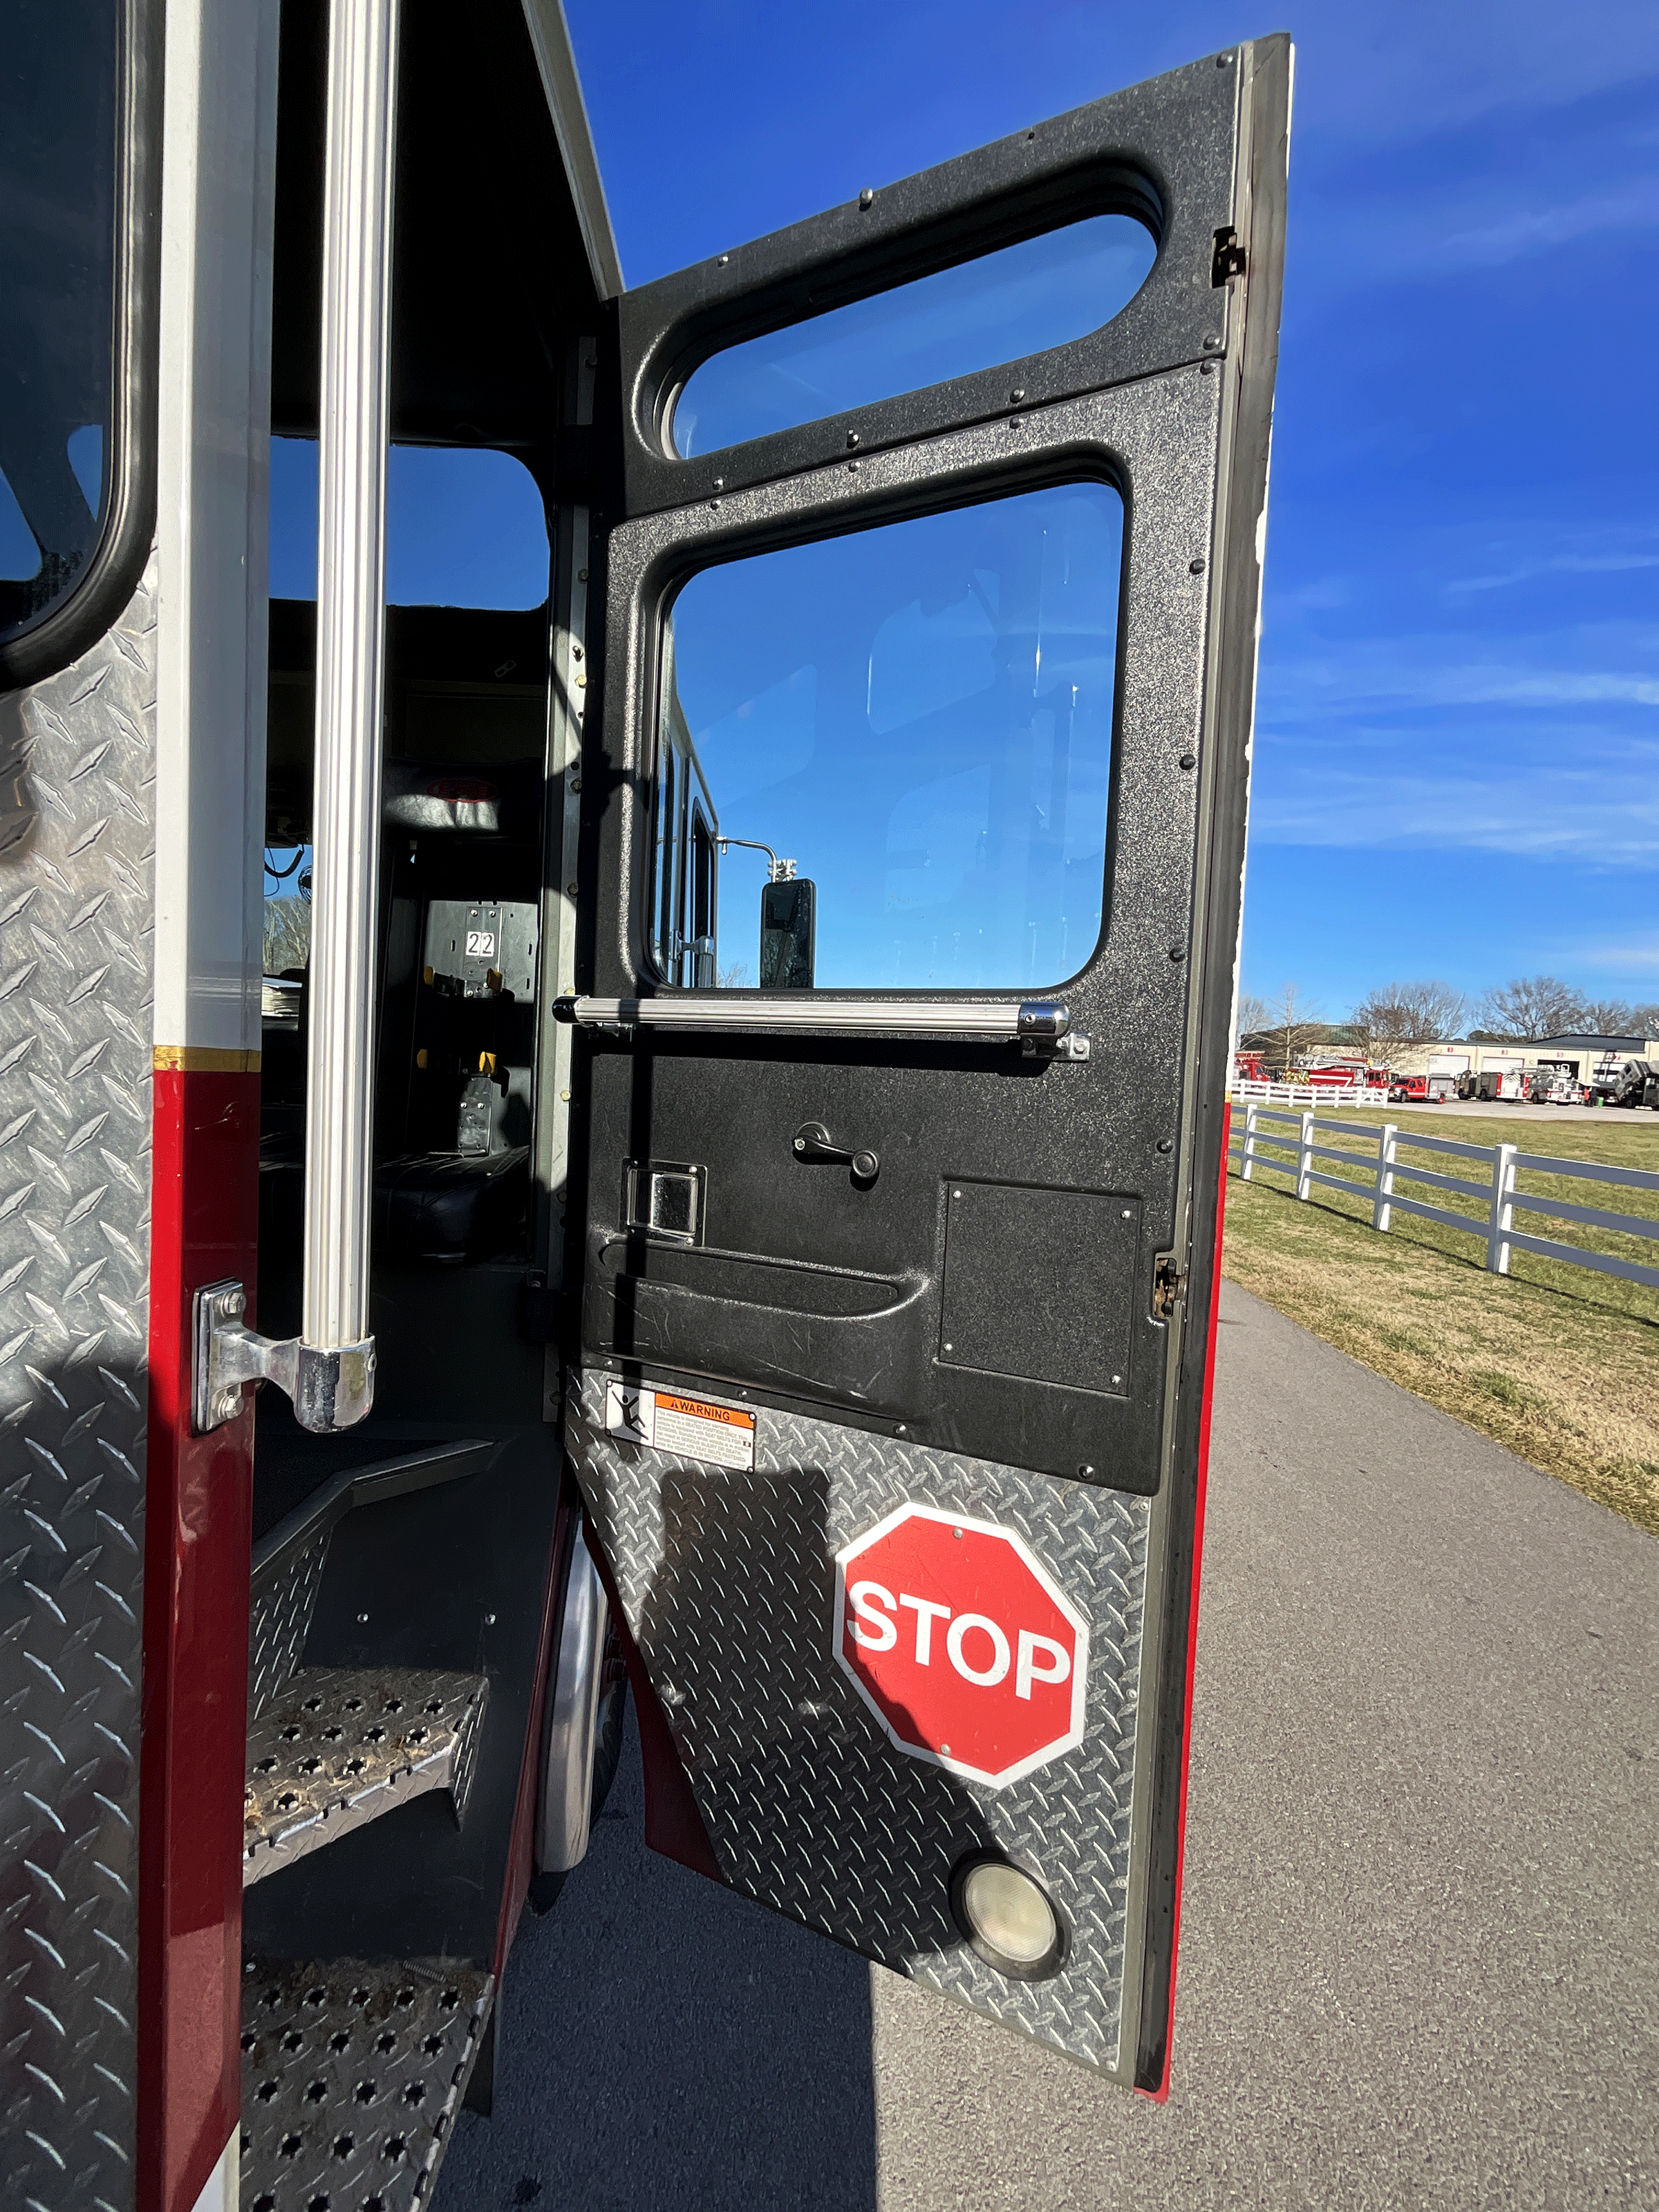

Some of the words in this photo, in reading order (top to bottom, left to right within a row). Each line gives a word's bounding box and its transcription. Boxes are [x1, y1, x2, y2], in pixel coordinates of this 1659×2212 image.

[468, 933, 493, 954] 22
[679, 1402, 730, 1421] WARNING
[846, 1581, 1071, 1700] STOP
